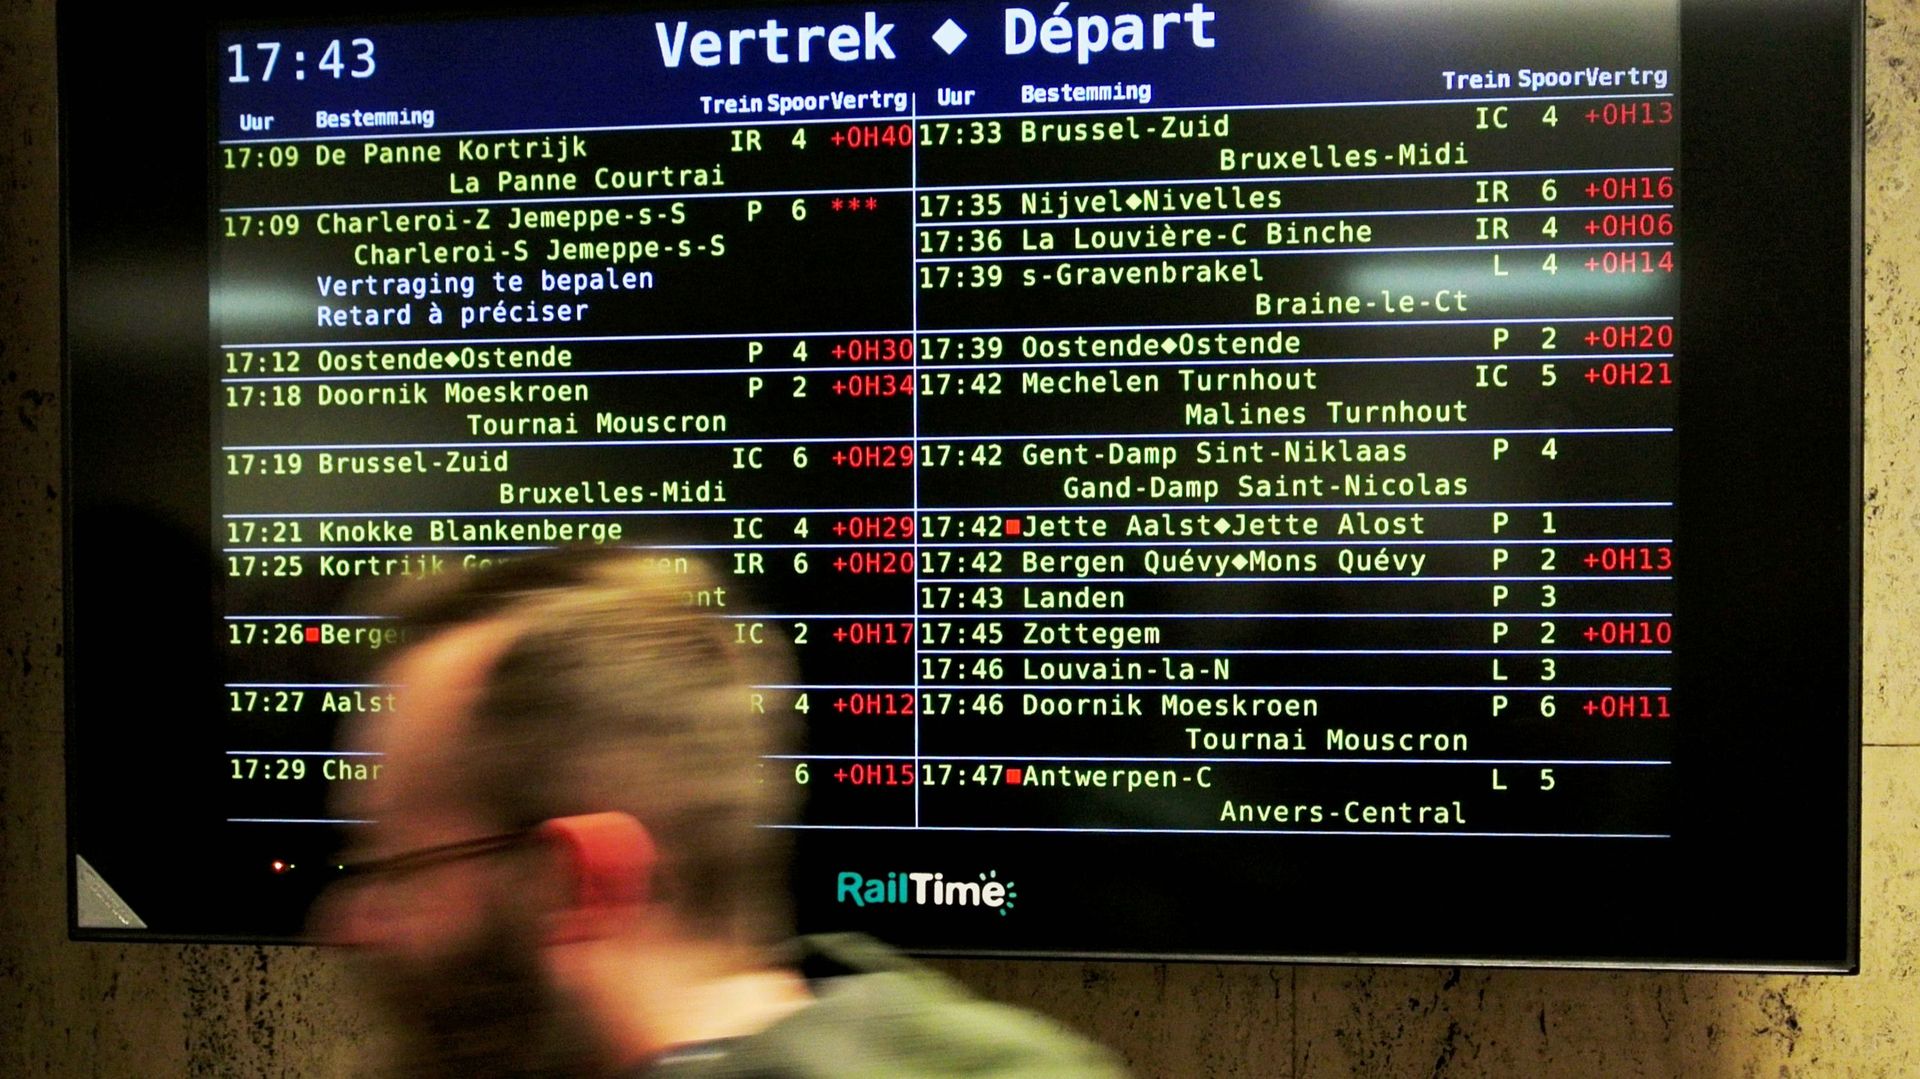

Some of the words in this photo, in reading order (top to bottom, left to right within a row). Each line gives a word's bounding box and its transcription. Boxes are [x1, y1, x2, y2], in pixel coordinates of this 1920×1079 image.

[654, 11, 897, 68] Vertrek
[1004, 1, 1216, 65] Départ
[227, 37, 376, 83] 17:43
[937, 87, 976, 107] Uur
[1021, 81, 1152, 104] Bestemming
[1442, 70, 1511, 91] Trein
[239, 113, 275, 132] Uur
[315, 107, 435, 129] Bestemming
[700, 94, 763, 114] Trein
[919, 120, 1002, 146] 17:33
[1021, 113, 1229, 143] Brussel-Zuid
[1475, 105, 1508, 130] IC
[1541, 104, 1559, 128] 4
[223, 145, 299, 169] 17:09
[315, 144, 346, 166] De
[364, 142, 442, 165] Panne
[458, 134, 587, 163] Kortrijk
[730, 129, 762, 152] IR
[791, 127, 807, 150] 4
[1220, 141, 1469, 171] Bruxelles-Midi
[450, 172, 480, 194] La
[498, 170, 577, 193] Panne
[594, 163, 725, 190] Courtrai
[919, 193, 1002, 218] 17:35
[1476, 180, 1510, 203] IR
[1541, 178, 1558, 202] 6
[224, 213, 300, 238] 17:09
[316, 208, 491, 235] Charleroi-Z
[507, 201, 686, 232] Jemeppe-s-S
[747, 199, 763, 222] P
[791, 198, 807, 221] 6
[354, 239, 529, 266] Charleroi-S
[546, 234, 726, 264] Jemeppe-s-S
[920, 228, 1003, 253] 17:36
[1022, 228, 1054, 251] La
[1074, 222, 1247, 250] Louvière-C
[1266, 220, 1372, 245] Binche
[1475, 217, 1510, 240] IR
[1541, 216, 1558, 239] 4
[316, 272, 475, 300] Vertraging
[492, 271, 523, 293] te
[541, 268, 654, 296] bepalen
[920, 264, 1003, 289] 17:39
[1023, 257, 1264, 287] s-Gravenbrakel
[1494, 254, 1509, 277] L
[1541, 252, 1558, 276] 4
[317, 303, 411, 327] Retard
[428, 301, 443, 325] à
[461, 299, 589, 329] préciser
[1255, 289, 1467, 316] Braine-le-Ct
[225, 350, 300, 374] 17:12
[748, 341, 764, 364] P
[792, 340, 808, 362] 4
[920, 336, 1003, 360] 17:39
[1493, 327, 1509, 350] P
[1541, 326, 1557, 350] 2
[226, 384, 302, 408] 17:18
[318, 382, 428, 406] Doornik
[444, 380, 589, 404] Moeskroen
[748, 376, 764, 399] P
[792, 375, 807, 398] 2
[920, 372, 1002, 396] 17:42
[1022, 369, 1159, 394] Mechelen
[1177, 367, 1317, 392] Turnhout
[1475, 363, 1508, 388] IC
[1541, 363, 1557, 387] 5
[466, 412, 579, 436] Tournai
[596, 411, 727, 434] Mouscron
[1185, 401, 1306, 426] Malines
[1326, 399, 1468, 424] Turnhout
[226, 452, 303, 476] 17:19
[319, 449, 508, 474] Brussel-Zuid
[732, 446, 763, 470] IC
[793, 446, 808, 469] 6
[920, 443, 1002, 467] 17:42
[1022, 442, 1177, 470] Gent-Damp
[1196, 438, 1407, 464] Sint-Niklaas
[1493, 437, 1509, 461] P
[1541, 437, 1558, 461] 4
[499, 479, 727, 504] Bruxelles-Midi
[1063, 475, 1219, 503] Gand-Damp
[1238, 472, 1468, 498] Saint-Nicolas
[227, 521, 303, 543] 17:21
[319, 520, 413, 542] Knokke
[430, 518, 622, 544] Blankenberge
[733, 516, 763, 540] IC
[793, 516, 809, 539] 4
[921, 515, 1003, 538] 17:42
[1022, 515, 1107, 538] Jette
[1337, 511, 1425, 535] Alost
[1493, 511, 1509, 534] P
[1542, 511, 1557, 534] 1
[228, 555, 303, 577] 17:25
[320, 554, 444, 577] Kortrijk
[733, 552, 765, 575] IR
[793, 551, 809, 575] 6
[921, 550, 1003, 574] 17:42
[1022, 550, 1124, 578] Bergen
[1338, 547, 1426, 577] Quévy
[1493, 548, 1509, 571] P
[1540, 547, 1556, 571] 2
[921, 586, 1004, 609] 17:43
[1023, 586, 1125, 609] Landen
[1493, 584, 1509, 608] P
[1540, 584, 1557, 608] 3
[228, 623, 304, 645] 17:26
[794, 622, 808, 645] 2
[921, 622, 1003, 645] 17:45
[1023, 622, 1160, 650] Zottegem
[1492, 621, 1509, 644] P
[1540, 621, 1556, 644] 2
[921, 657, 1004, 680] 17:46
[1024, 656, 1229, 681] Louvain-la-N
[1492, 658, 1509, 681] L
[1540, 657, 1556, 681] 3
[229, 690, 304, 713] 17:27
[794, 692, 810, 715] 4
[921, 693, 1004, 716] 17:46
[1023, 693, 1143, 716] Doornik
[1161, 693, 1318, 717] Moeskroen
[1492, 695, 1508, 717] P
[1540, 694, 1556, 718] 6
[1184, 727, 1307, 751] Tournai
[1326, 728, 1468, 752] Mouscron
[231, 758, 306, 780] 17:29
[794, 762, 810, 785] 6
[922, 763, 1004, 786] 17:47
[1022, 764, 1212, 793] Antwerpen-C
[1492, 768, 1508, 790] L
[1540, 768, 1556, 791] 5
[1219, 799, 1466, 824] Anvers-Central
[837, 871, 1006, 907] RailTime
